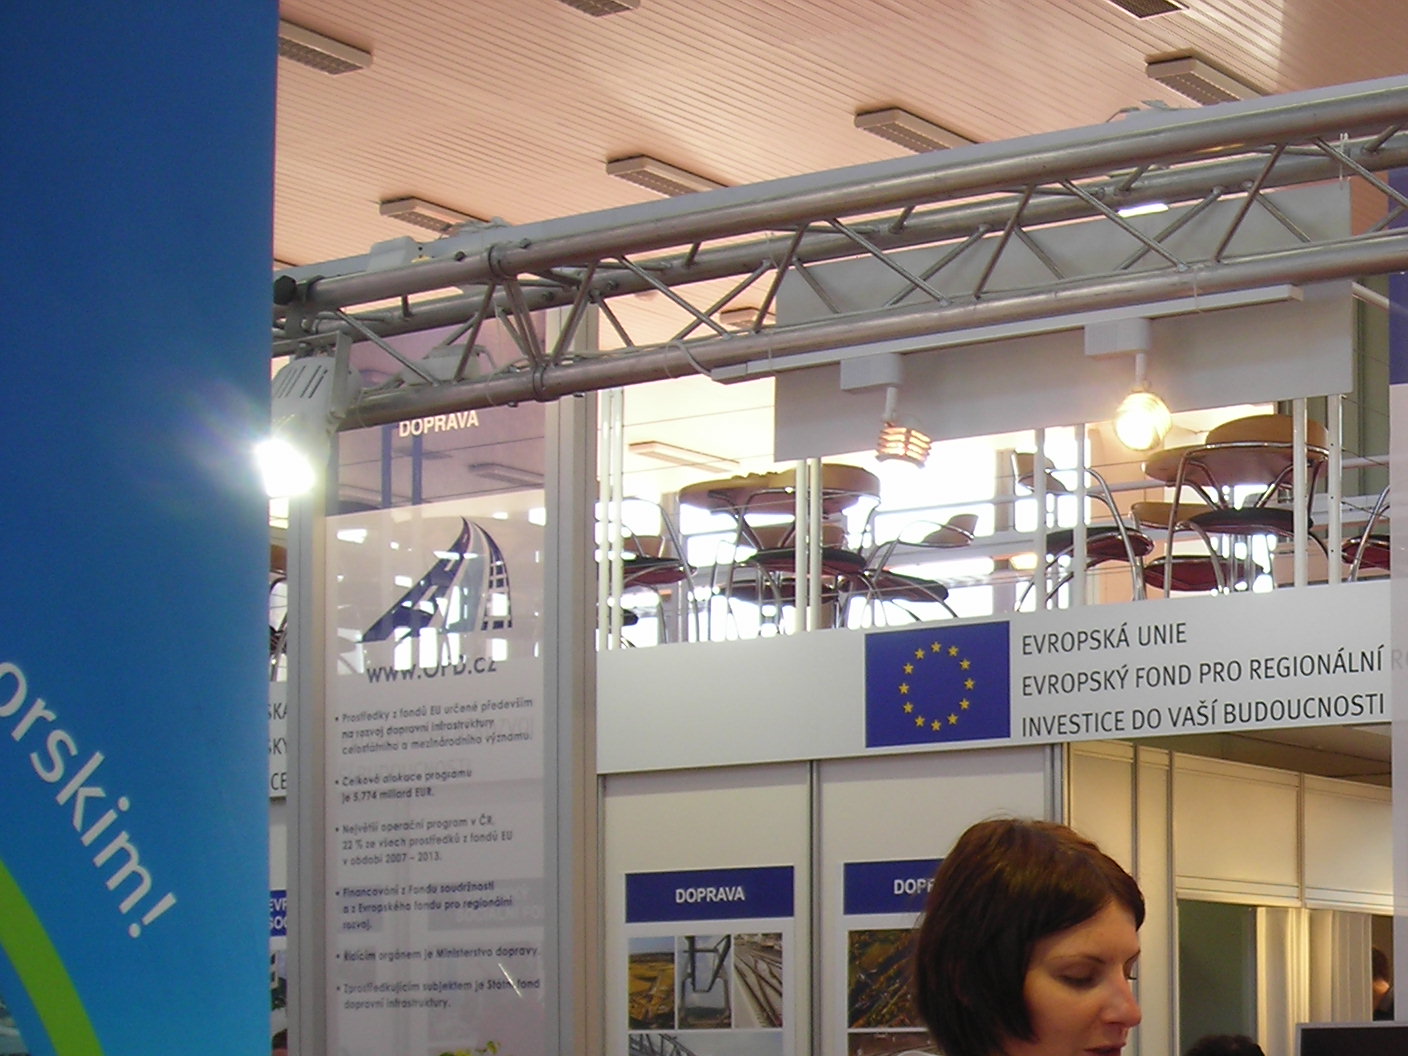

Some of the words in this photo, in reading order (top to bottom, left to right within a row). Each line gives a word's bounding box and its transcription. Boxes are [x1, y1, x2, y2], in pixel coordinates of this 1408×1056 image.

[399, 410, 479, 437] DOPRAVA
[1022, 622, 1129, 656] EVROPSKÁ
[1138, 623, 1188, 646] UNIE
[1022, 664, 1128, 697] EVROPSKÝ
[1135, 663, 1192, 689] FOND
[1199, 658, 1242, 683] PRO
[1250, 645, 1384, 680] REGIONÁLNÍ
[430, 705, 440, 715] EU
[1022, 705, 1125, 738] INVESTICE
[1132, 707, 1162, 732] DO
[1168, 699, 1217, 729] VAŠÍ
[1223, 693, 1385, 726] BUDOUCNOSTI
[675, 886, 745, 903] DOPRAVA
